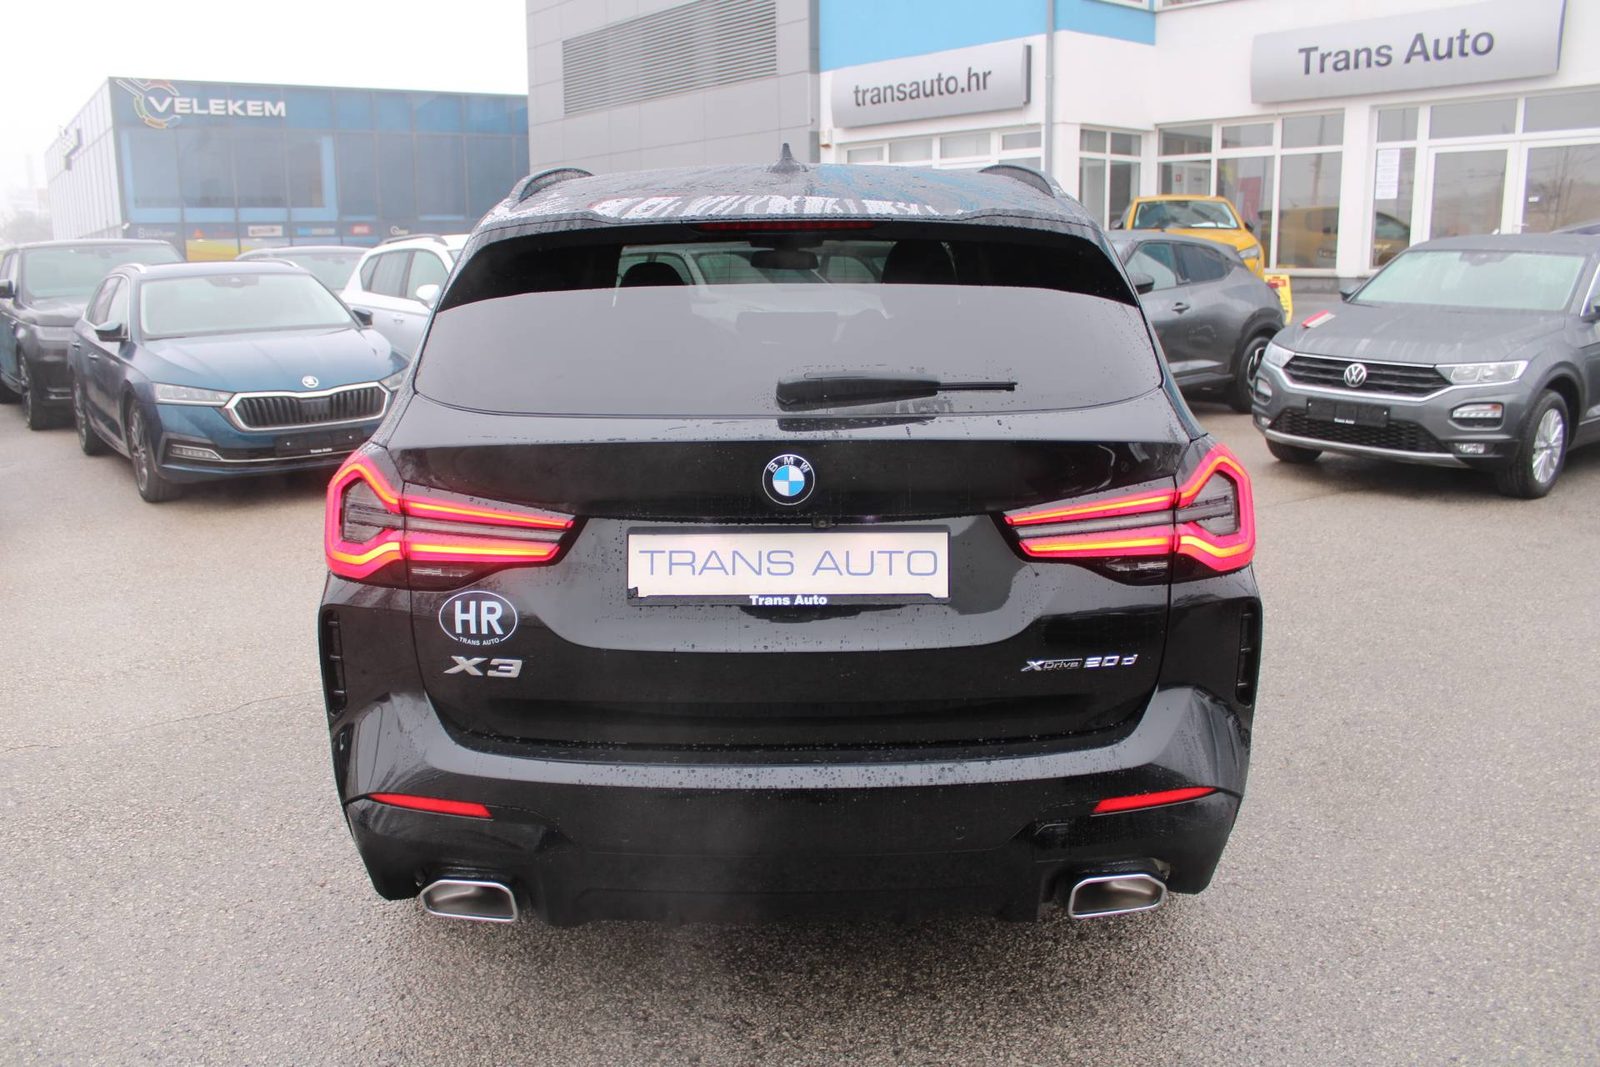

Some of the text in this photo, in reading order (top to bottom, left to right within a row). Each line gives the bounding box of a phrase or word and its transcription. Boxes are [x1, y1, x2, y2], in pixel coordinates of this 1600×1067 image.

[1298, 28, 1494, 75] Trans Auto
[853, 66, 992, 107] transauto.hr
[147, 96, 286, 118] VELEKEM
[767, 456, 811, 473] BMW
[638, 549, 938, 577] TRANS AUTO
[749, 594, 828, 606] Trans Auto
[454, 600, 504, 635] HR
[459, 636, 500, 646] TRANS AUTO
[443, 655, 523, 678] X3
